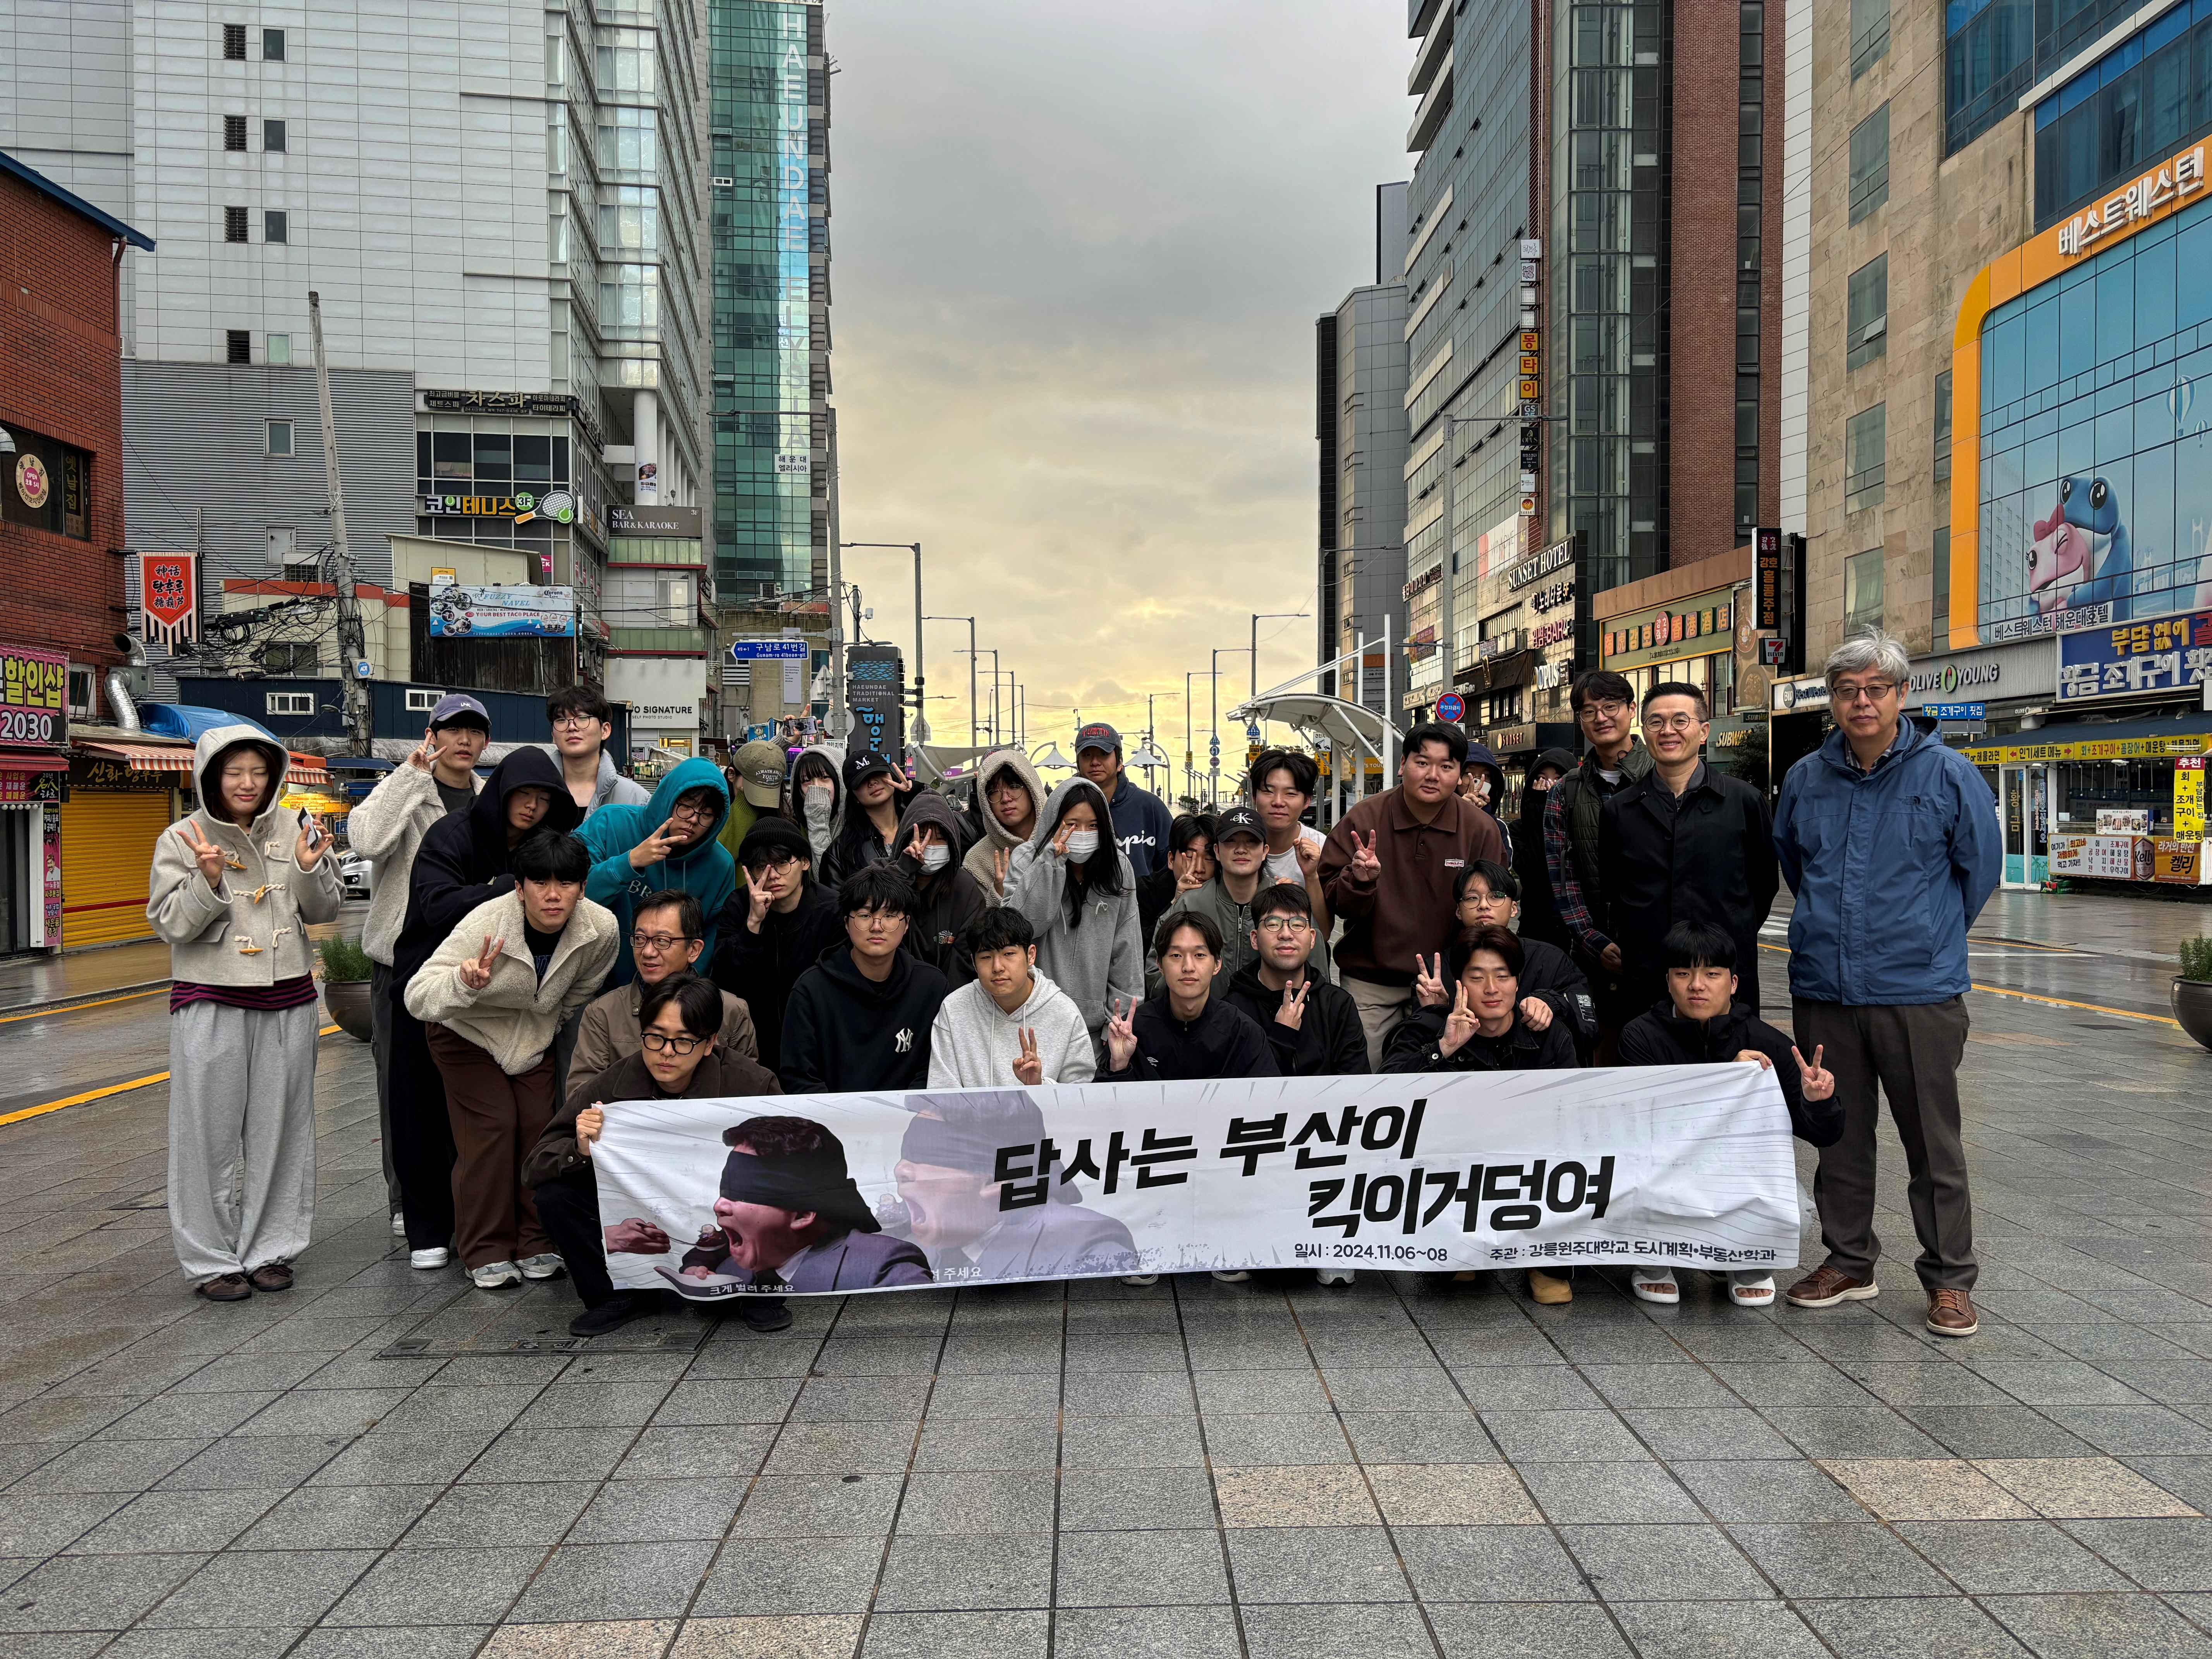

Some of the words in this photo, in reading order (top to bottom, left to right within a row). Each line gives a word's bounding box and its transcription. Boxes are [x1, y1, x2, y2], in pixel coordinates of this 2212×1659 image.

[782, 12, 805, 253] HAEUNDAE
[2058, 147, 2205, 256] 베스트웨스턴
[785, 276, 807, 448] ELYSIA
[466, 390, 527, 408] 차스파
[532, 394, 566, 402] 아로마테라피
[532, 404, 566, 412] 타이테라피
[426, 495, 516, 515] 코인테니스
[517, 496, 533, 508] 3F
[612, 509, 634, 519] SEA
[155, 564, 181, 578] 神话
[1508, 556, 1538, 589] SUNSET
[1540, 541, 1570, 574] HOTEL
[152, 578, 185, 594] 탕후루
[1994, 615, 2053, 641] 베스트웨스턴
[2111, 625, 2151, 656] 부담
[2153, 618, 2190, 651] 없이
[756, 643, 781, 652] 구남로
[782, 643, 806, 652] 41번길
[1769, 641, 1783, 664] 7
[1538, 663, 1560, 690] OPUS
[1910, 672, 1941, 692] OLIVE
[1956, 664, 1999, 685] YOUNG
[2060, 662, 2100, 697] 황금
[2102, 651, 2181, 690] 조개구이
[0, 657, 64, 709] 할인샵
[1925, 706, 1938, 716] 황금
[1941, 706, 1966, 716] 조개구이
[1970, 706, 1983, 716] 횟집
[0, 711, 52, 741] 2030
[1977, 750, 2000, 762] 해물라면
[2020, 746, 2046, 759] 인기세트
[2048, 745, 2062, 758] 메뉴
[2178, 757, 2201, 768] 추천
[6, 772, 26, 781] 사업운
[2181, 771, 2190, 781] 회
[6, 782, 26, 790] 재물운
[6, 791, 26, 800] 매매운
[2176, 795, 2194, 804] 조개
[2176, 807, 2195, 817] 구이
[2051, 842, 2065, 851] 여기가
[2158, 840, 2179, 853] 라거의
[2057, 849, 2078, 859] 저렴하게
[2135, 849, 2153, 866] Kelly
[2057, 860, 2067, 869] 먹고
[2170, 854, 2195, 874] 켈리
[45, 917, 60, 927] 사은품
[47, 927, 58, 937] 증정
[993, 1128, 1199, 1211] 답사는
[1219, 1098, 1428, 1177] 부산이
[1307, 1155, 1616, 1238] 킥이거덩여
[1333, 1243, 1448, 1261] 2024.11.06~08
[1528, 1240, 1630, 1258] 강릉원주대학교
[944, 1266, 982, 1281] 주세요
[710, 1284, 732, 1295] 크게
[761, 1284, 795, 1293] 주세요
